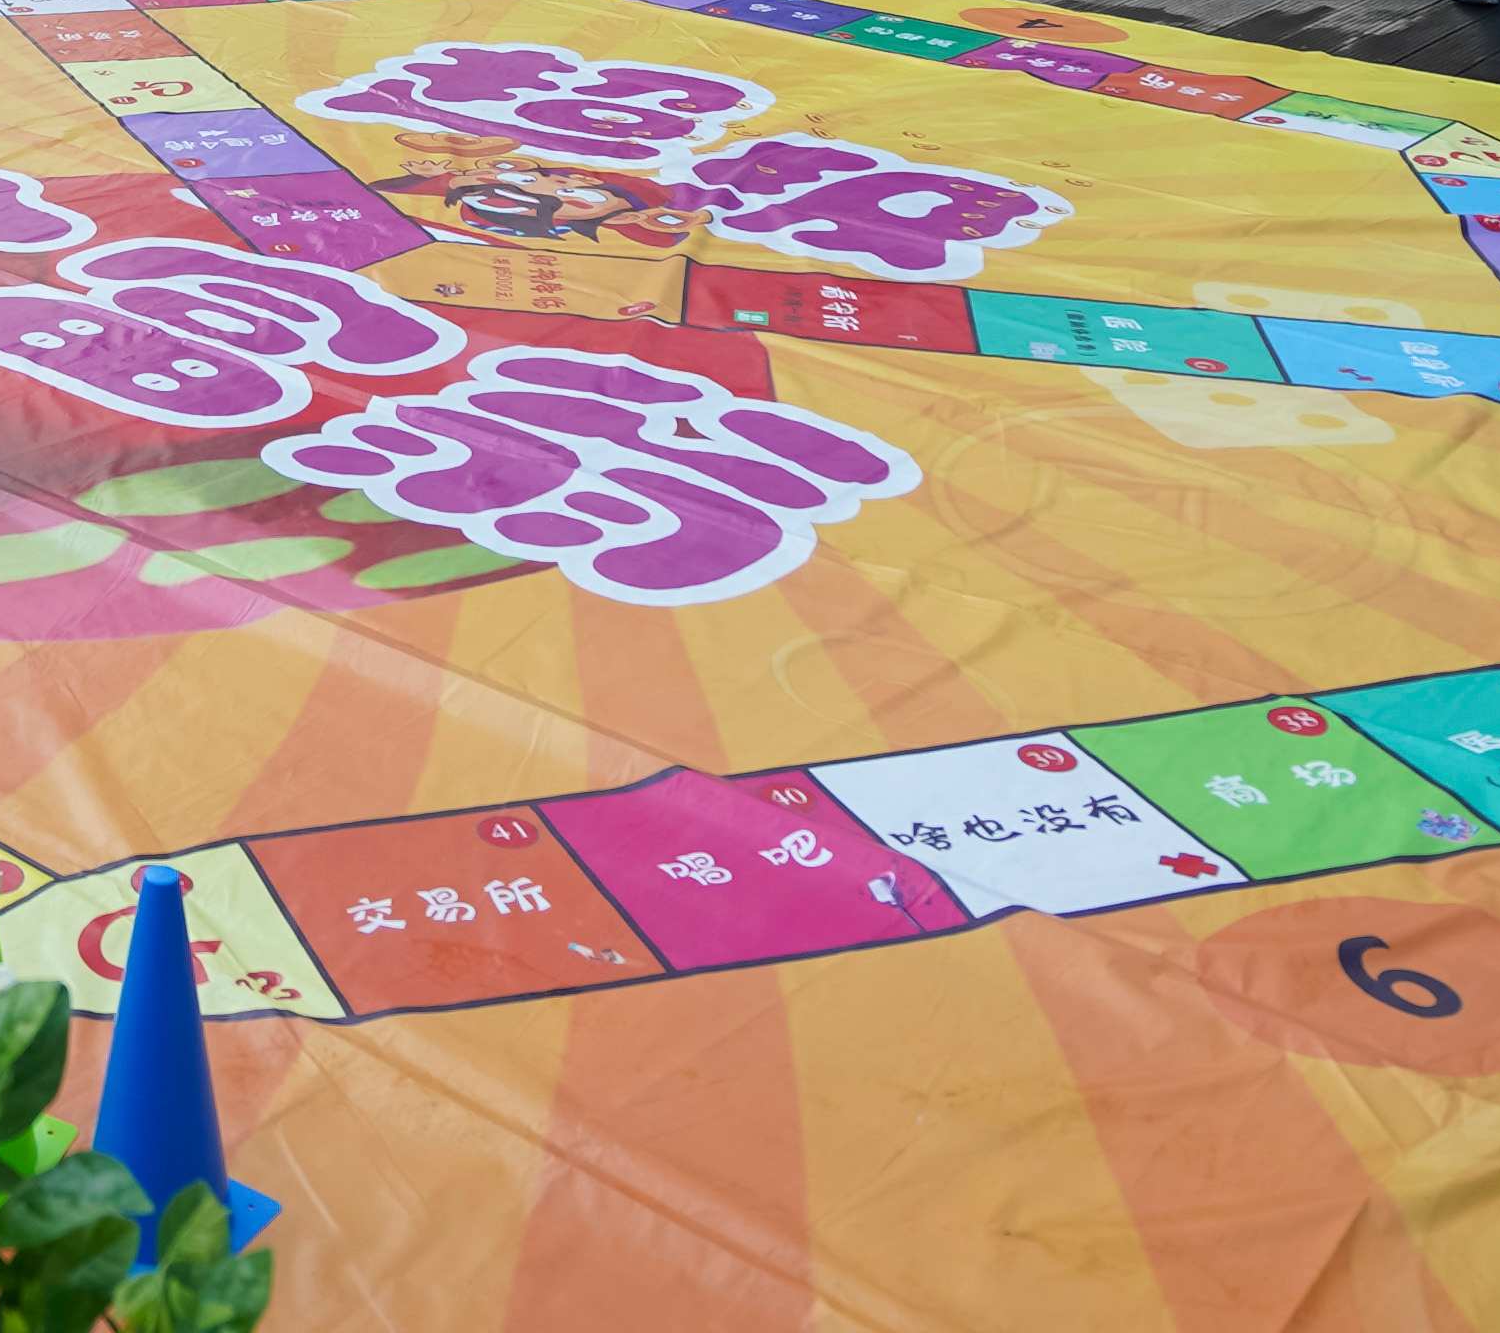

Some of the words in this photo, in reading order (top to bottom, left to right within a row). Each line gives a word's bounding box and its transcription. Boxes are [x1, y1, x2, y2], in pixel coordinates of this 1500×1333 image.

[305, 43, 1077, 283] 超级
[817, 285, 861, 332] 看守所
[1101, 314, 1153, 355] 医院
[1281, 710, 1318, 733] 38
[1031, 744, 1066, 770] 39
[771, 783, 809, 809] 40
[1204, 759, 1358, 811] 商场
[489, 817, 531, 843] 41
[890, 793, 1140, 854] 啥也没有
[660, 827, 833, 888] 唱吧
[346, 875, 551, 937] 交易所
[1337, 934, 1463, 1020] 6
